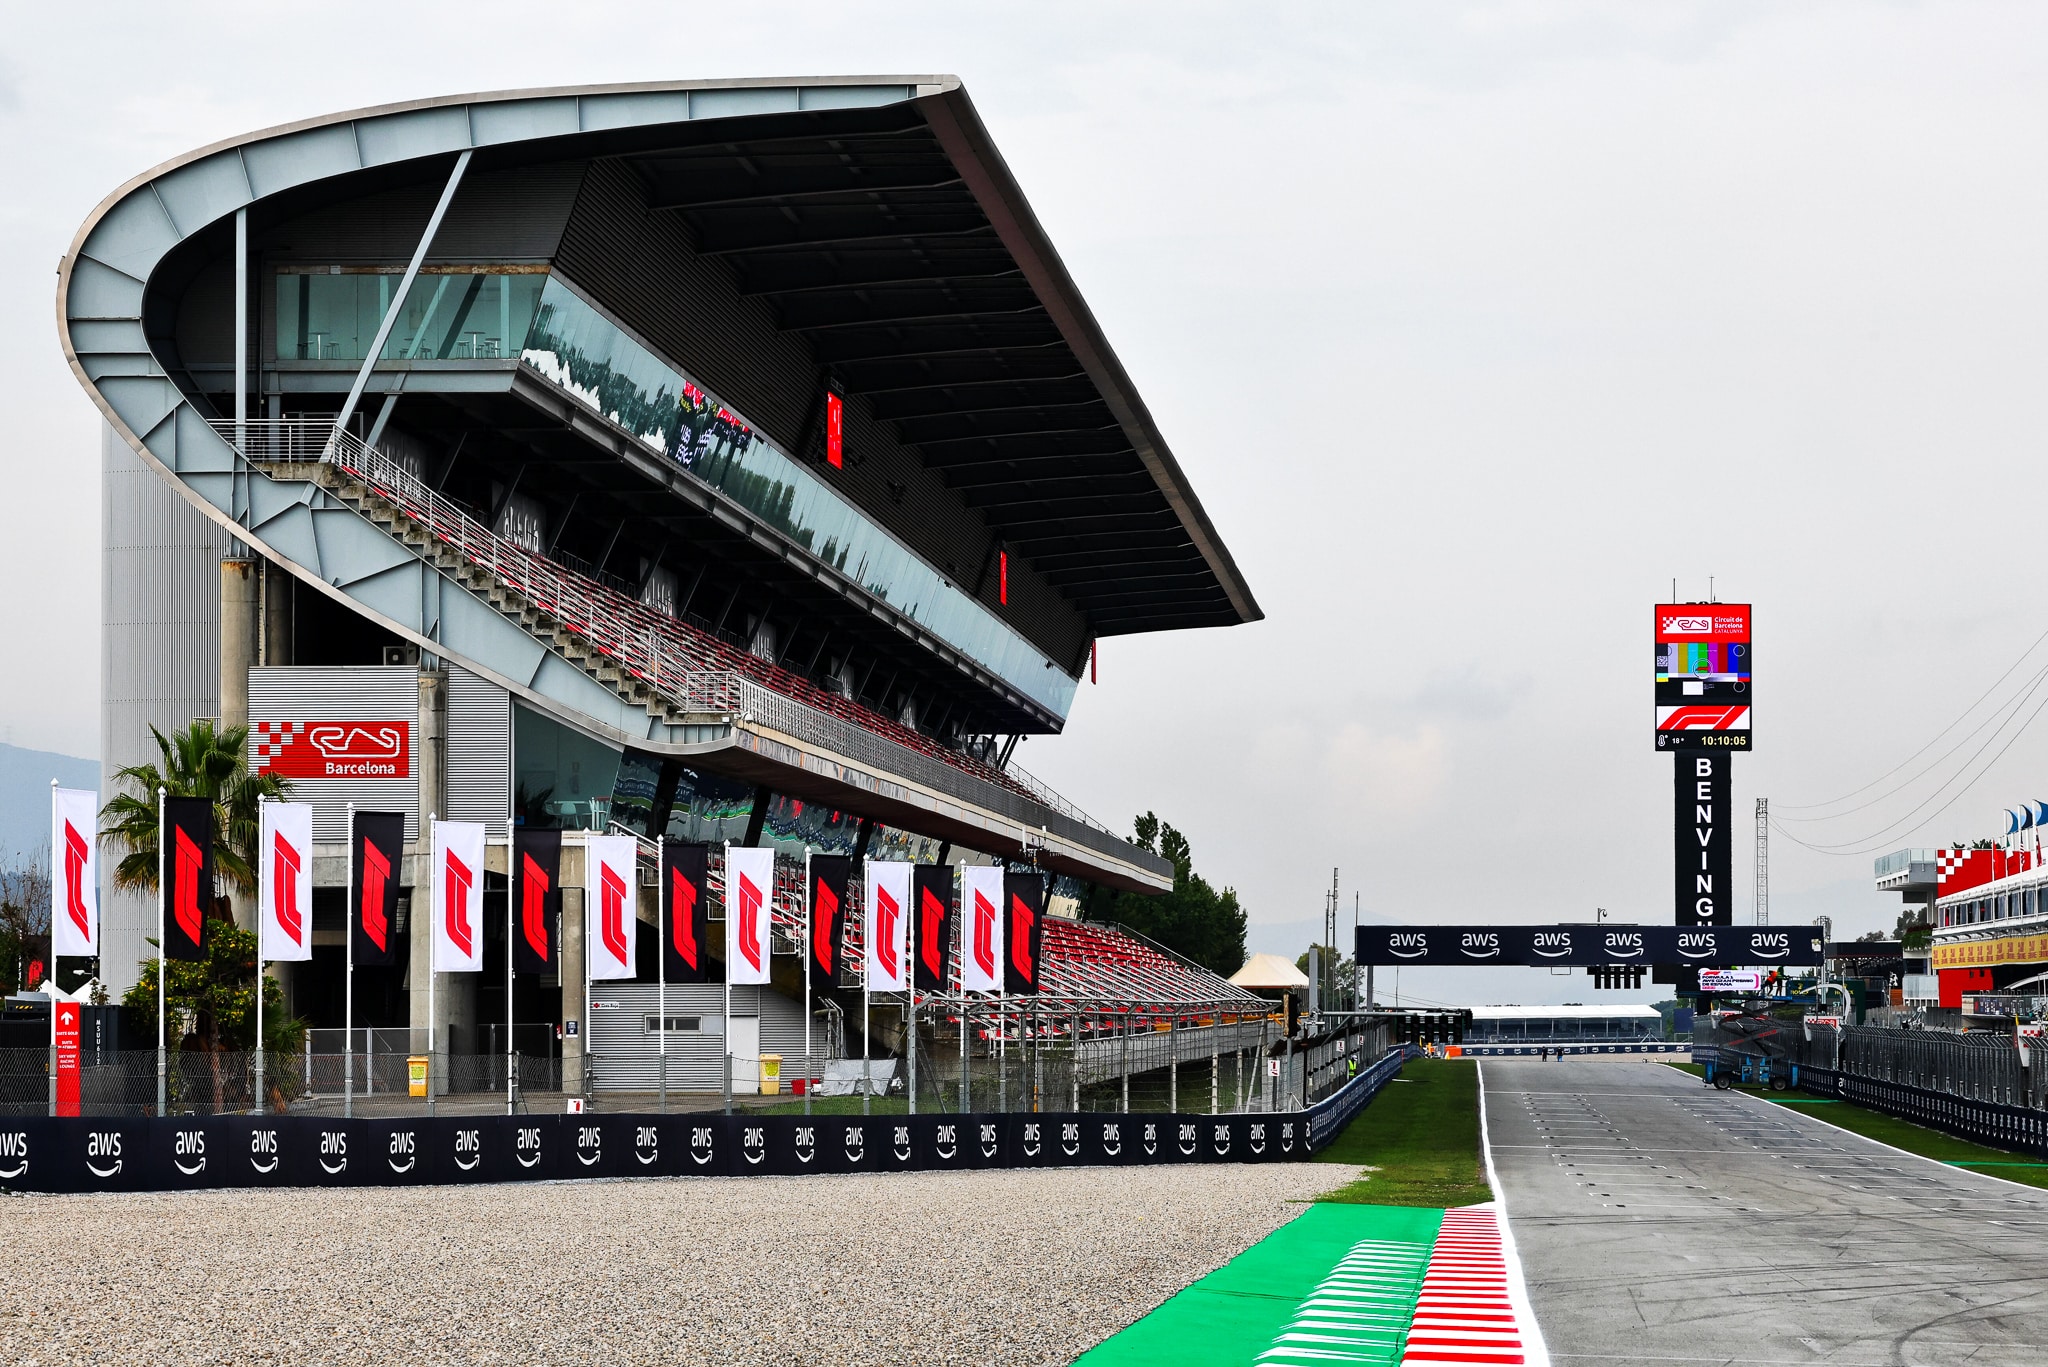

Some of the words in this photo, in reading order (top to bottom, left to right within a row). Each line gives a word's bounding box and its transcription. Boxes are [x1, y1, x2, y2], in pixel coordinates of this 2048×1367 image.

[1701, 736, 1746, 746] 10:10:05
[325, 761, 396, 775] Barcelona
[1696, 758, 1713, 926] BENVING
[1390, 933, 1426, 946] aws
[1462, 933, 1498, 946] aws
[1534, 933, 1570, 946] aws
[1606, 933, 1642, 946] aws
[1679, 933, 1715, 946] aws
[1752, 933, 1788, 946] aws
[518, 1128, 541, 1150] aws
[579, 1127, 601, 1148] aws
[637, 1127, 657, 1147] aws
[692, 1127, 713, 1148] aws
[745, 1127, 764, 1147] aws
[796, 1127, 815, 1147] aws
[846, 1127, 863, 1146] aws
[895, 1127, 910, 1145] aws
[938, 1125, 956, 1144] aws
[981, 1125, 997, 1142] aws
[1025, 1124, 1041, 1141] aws
[1063, 1124, 1079, 1141] aws
[1104, 1124, 1120, 1141] aws
[1145, 1124, 1156, 1141] aws
[1180, 1124, 1196, 1141] aws
[1215, 1124, 1230, 1141] aws
[1251, 1123, 1265, 1140] aws
[1283, 1123, 1294, 1139] aws
[0, 1132, 28, 1157] ws
[88, 1132, 122, 1157] aws
[176, 1131, 205, 1155] aws
[252, 1130, 278, 1154] aws
[321, 1131, 346, 1154] aws
[390, 1131, 415, 1155] aws
[456, 1130, 480, 1152] aws
